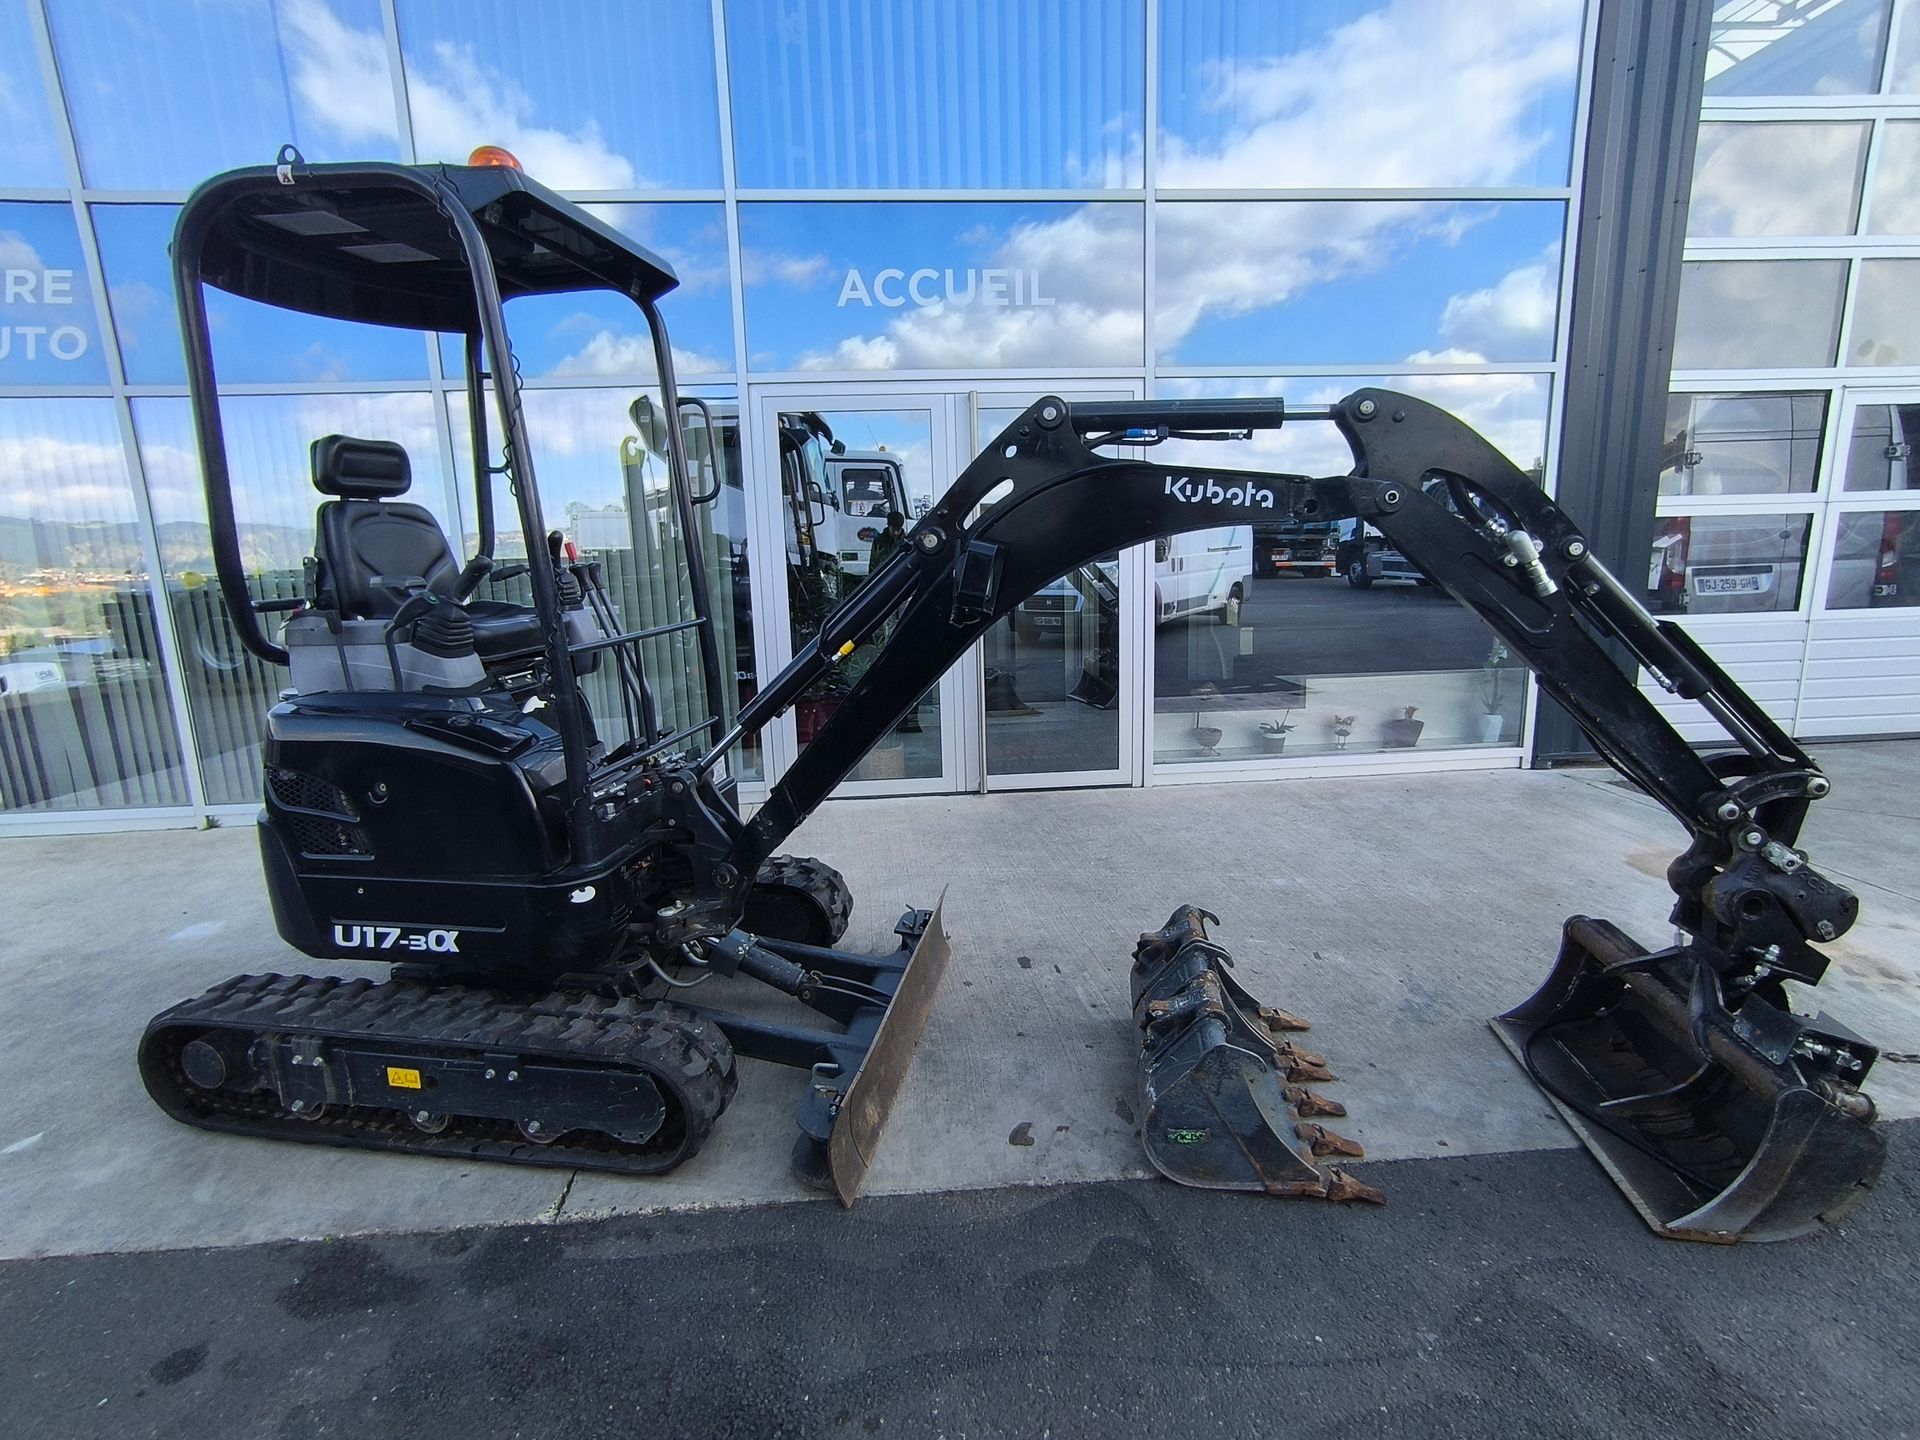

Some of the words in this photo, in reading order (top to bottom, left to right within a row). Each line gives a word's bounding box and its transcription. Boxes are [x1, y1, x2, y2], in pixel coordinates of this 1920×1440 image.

[5, 268, 73, 304] RE
[837, 268, 1056, 307] ACCUEIL
[1164, 476, 1274, 508] Kubota
